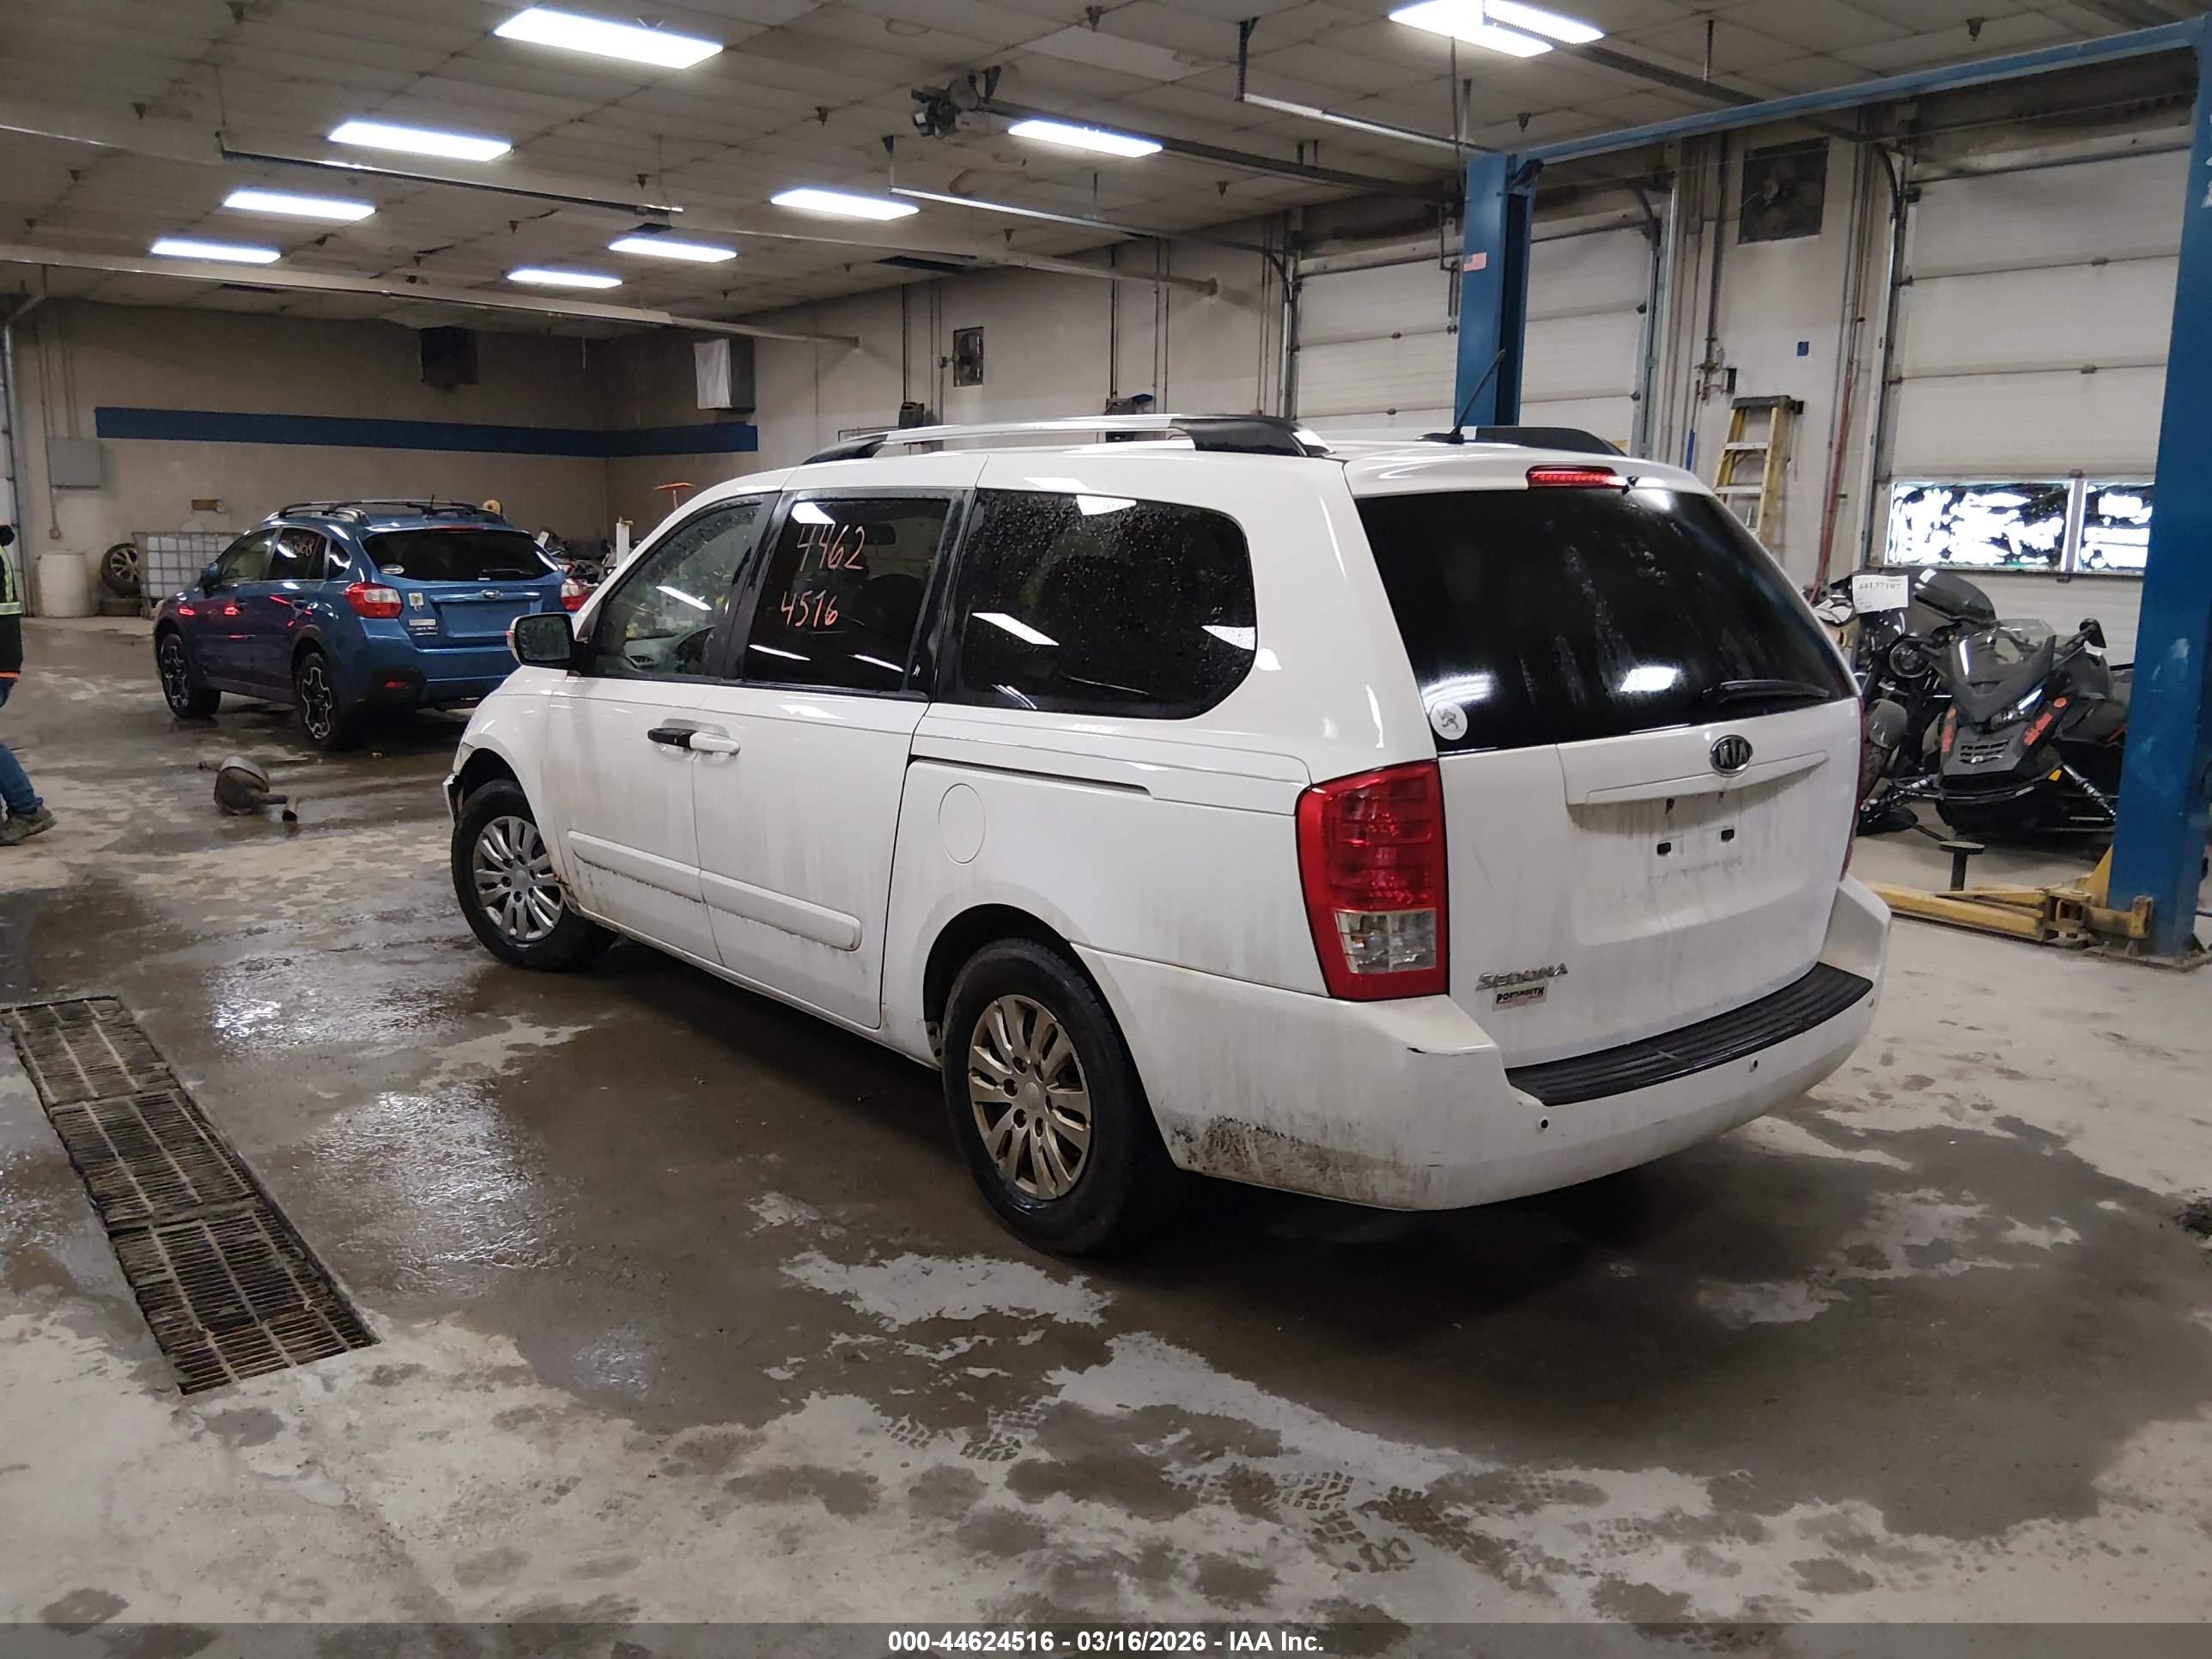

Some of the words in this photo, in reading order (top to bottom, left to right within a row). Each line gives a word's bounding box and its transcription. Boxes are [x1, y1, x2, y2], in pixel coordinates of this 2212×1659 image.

[796, 524, 866, 573] 4462
[780, 589, 839, 629] 4516
[1718, 741, 1749, 766] KIA
[1475, 962, 1569, 992] SEDONA
